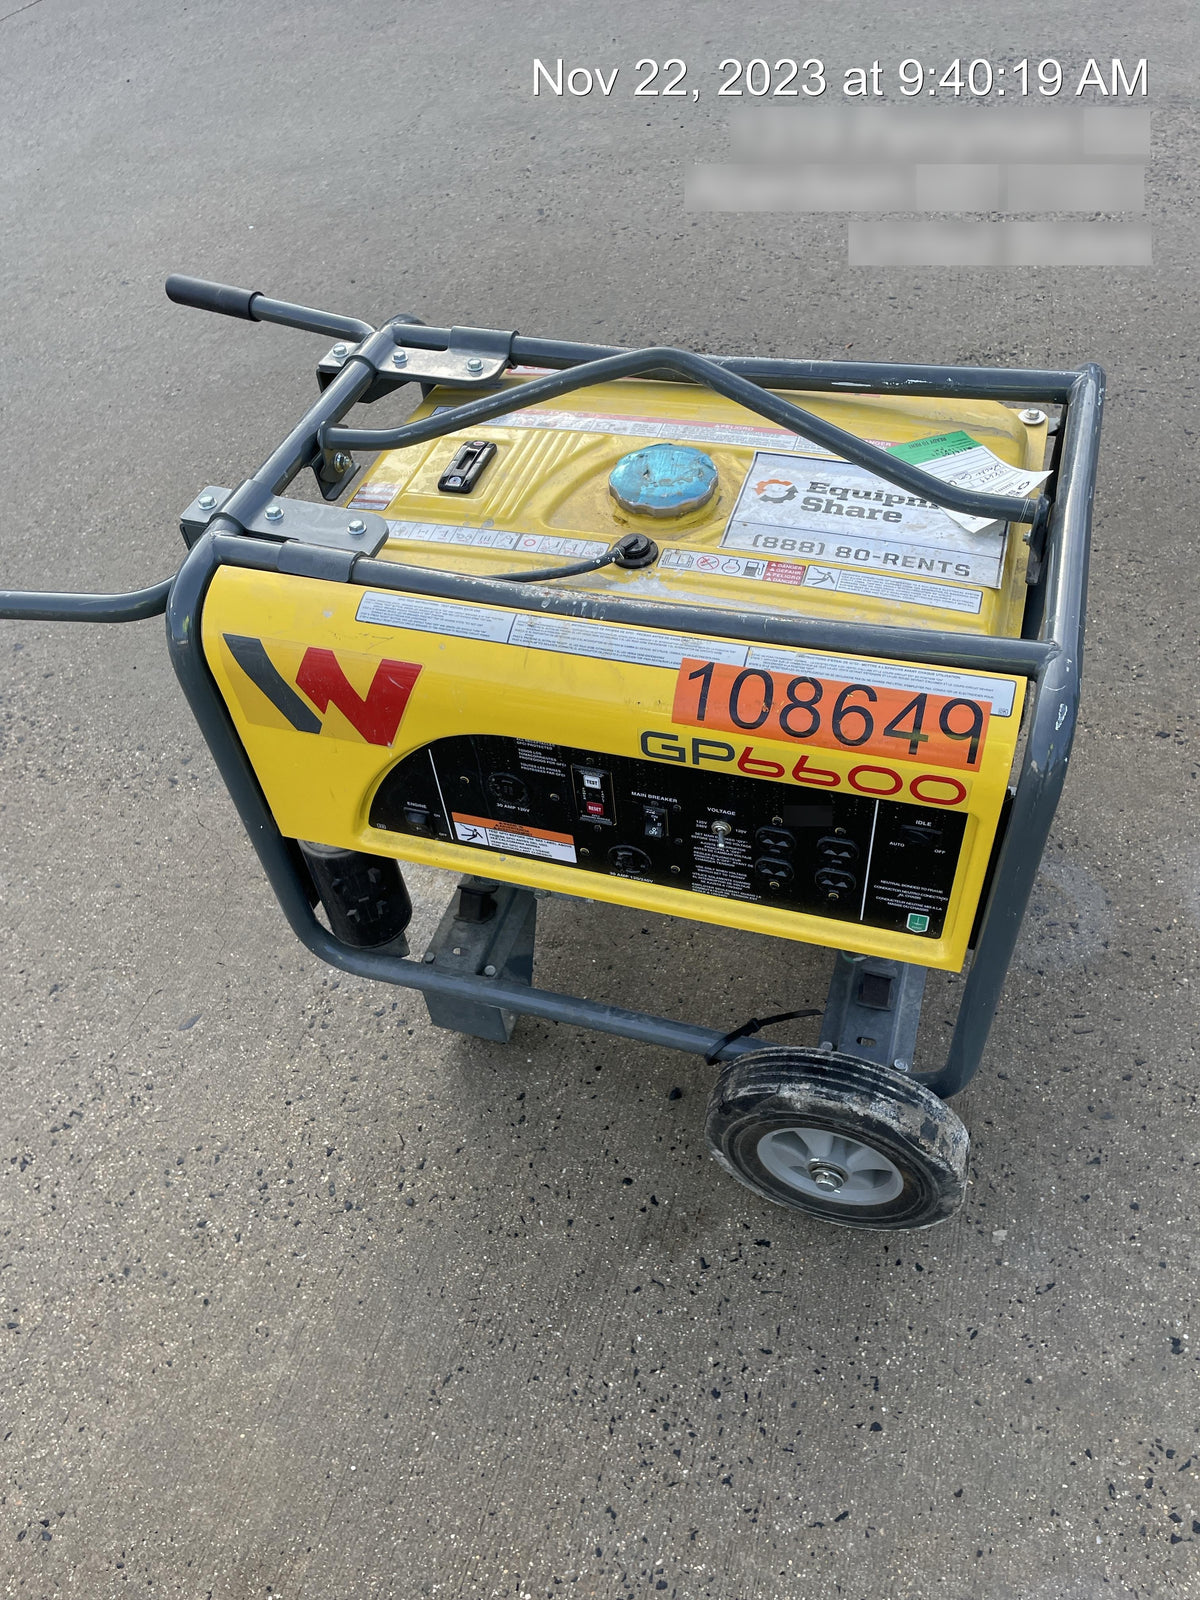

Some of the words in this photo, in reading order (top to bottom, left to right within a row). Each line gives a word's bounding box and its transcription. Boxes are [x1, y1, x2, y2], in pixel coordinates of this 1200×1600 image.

[799, 496, 904, 524] Share
[752, 533, 825, 556] (888)
[834, 545, 971, 578] 80-RENTS
[687, 661, 984, 765] 108649
[640, 730, 967, 806] GP6600
[631, 791, 647, 799] MAIN
[647, 794, 678, 803] BREAKER
[706, 806, 737, 816] VOLTAGE
